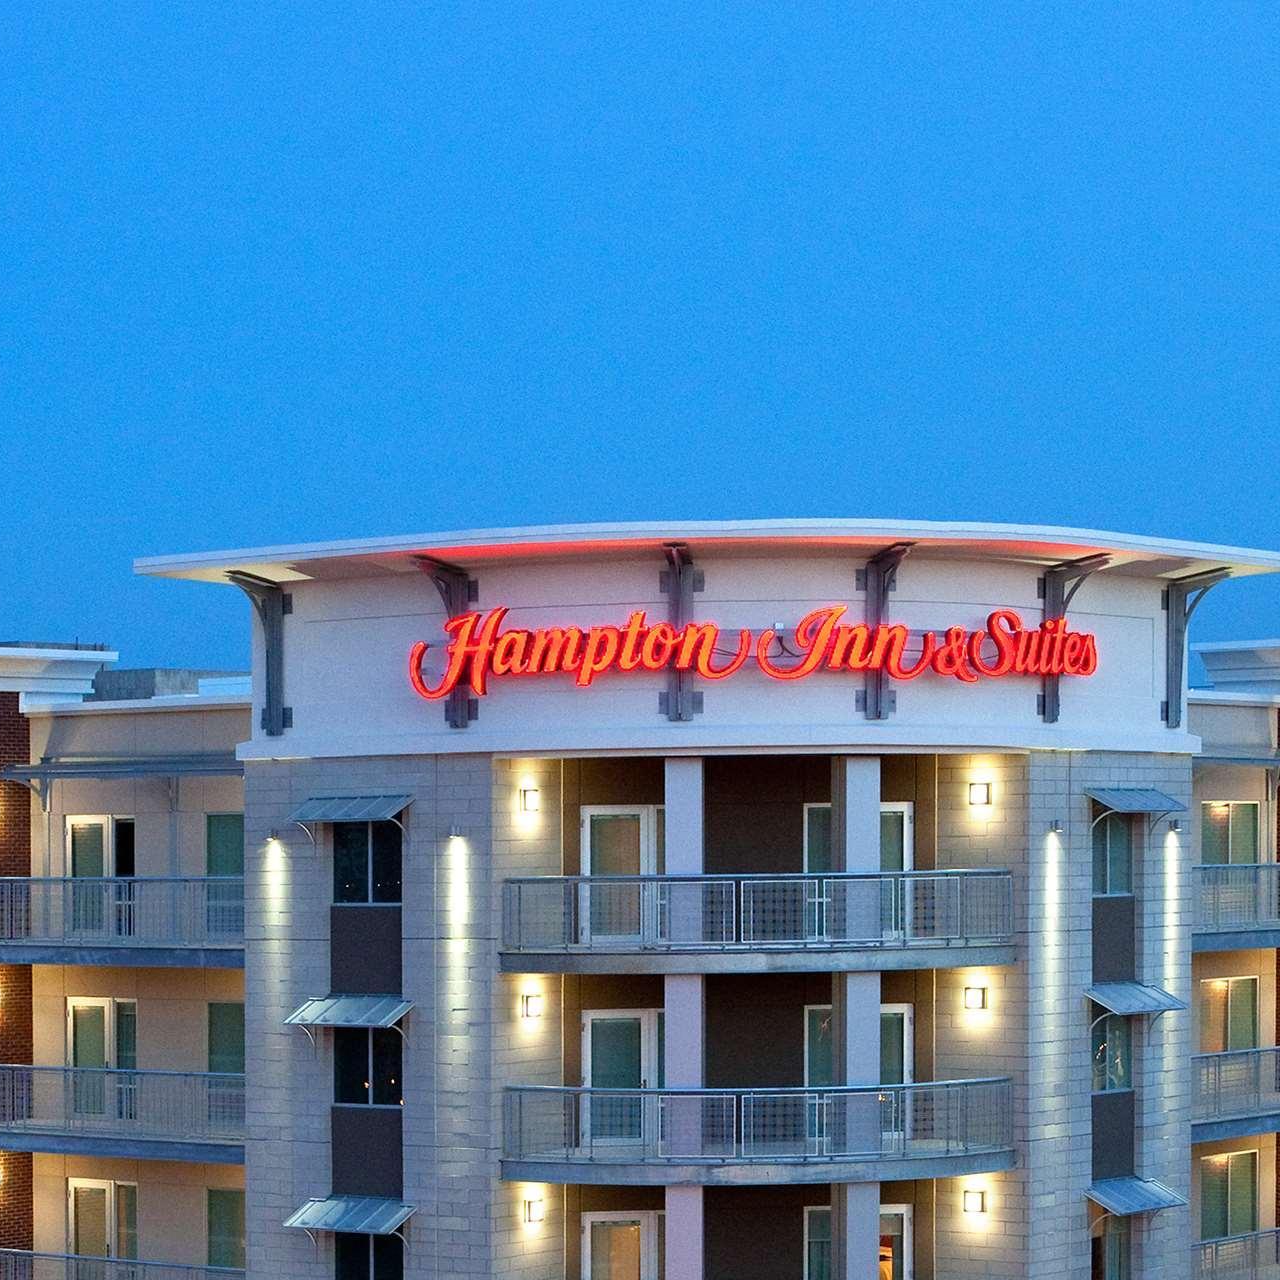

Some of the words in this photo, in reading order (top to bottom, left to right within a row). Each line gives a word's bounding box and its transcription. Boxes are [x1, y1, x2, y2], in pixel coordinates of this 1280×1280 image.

[408, 606, 752, 699] Hampton
[756, 603, 933, 681] Inn
[932, 624, 978, 683] &
[971, 608, 1098, 678] Suites
